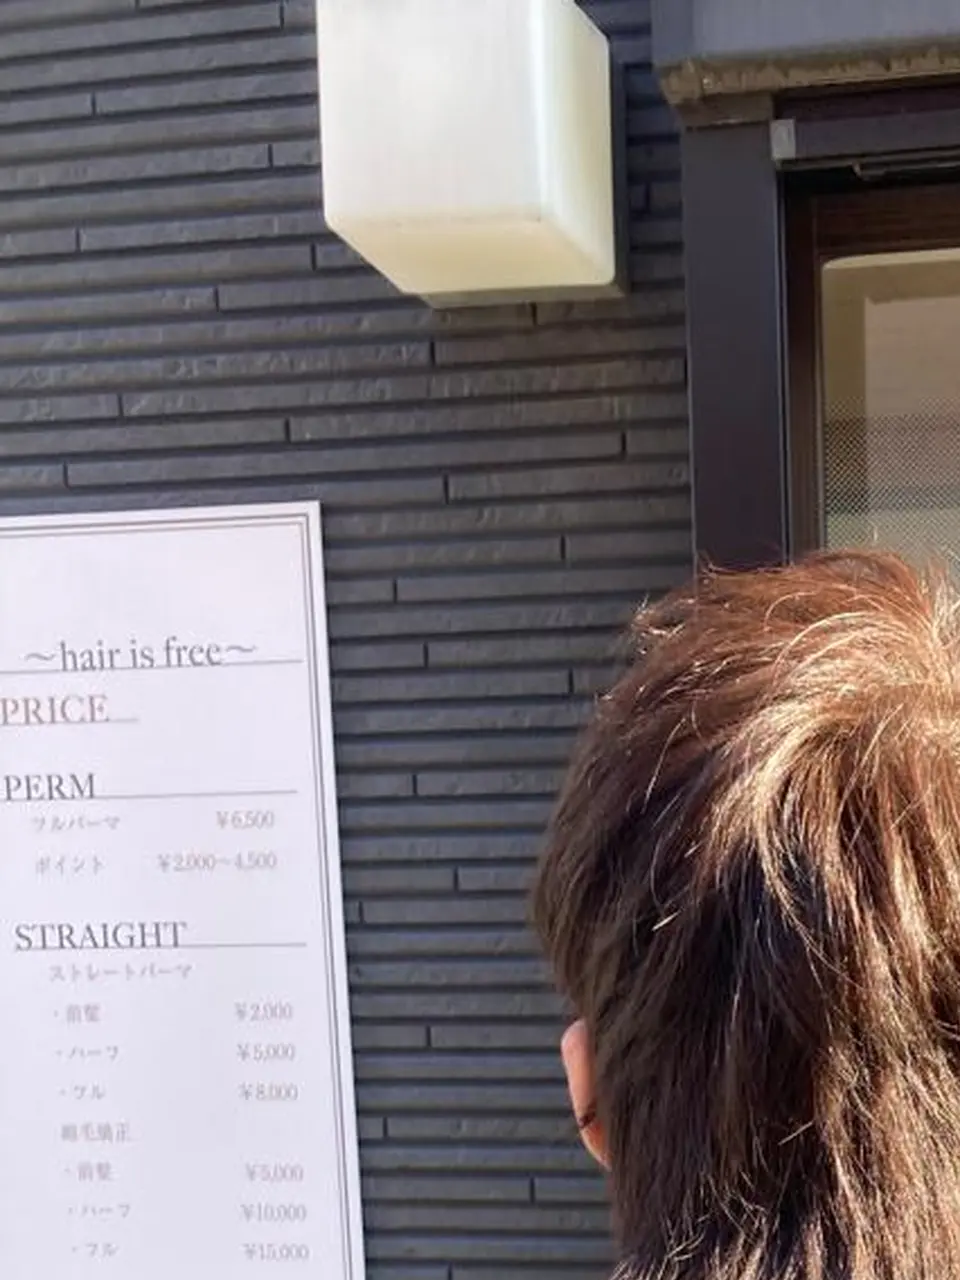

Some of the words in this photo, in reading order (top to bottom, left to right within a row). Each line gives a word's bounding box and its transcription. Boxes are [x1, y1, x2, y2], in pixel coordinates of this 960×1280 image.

[129, 640, 155, 669] is
[1, 694, 110, 725] PRICE
[4, 773, 96, 801] PERM
[35, 856, 104, 876] ポイント
[14, 921, 188, 950] STRAIGHT
